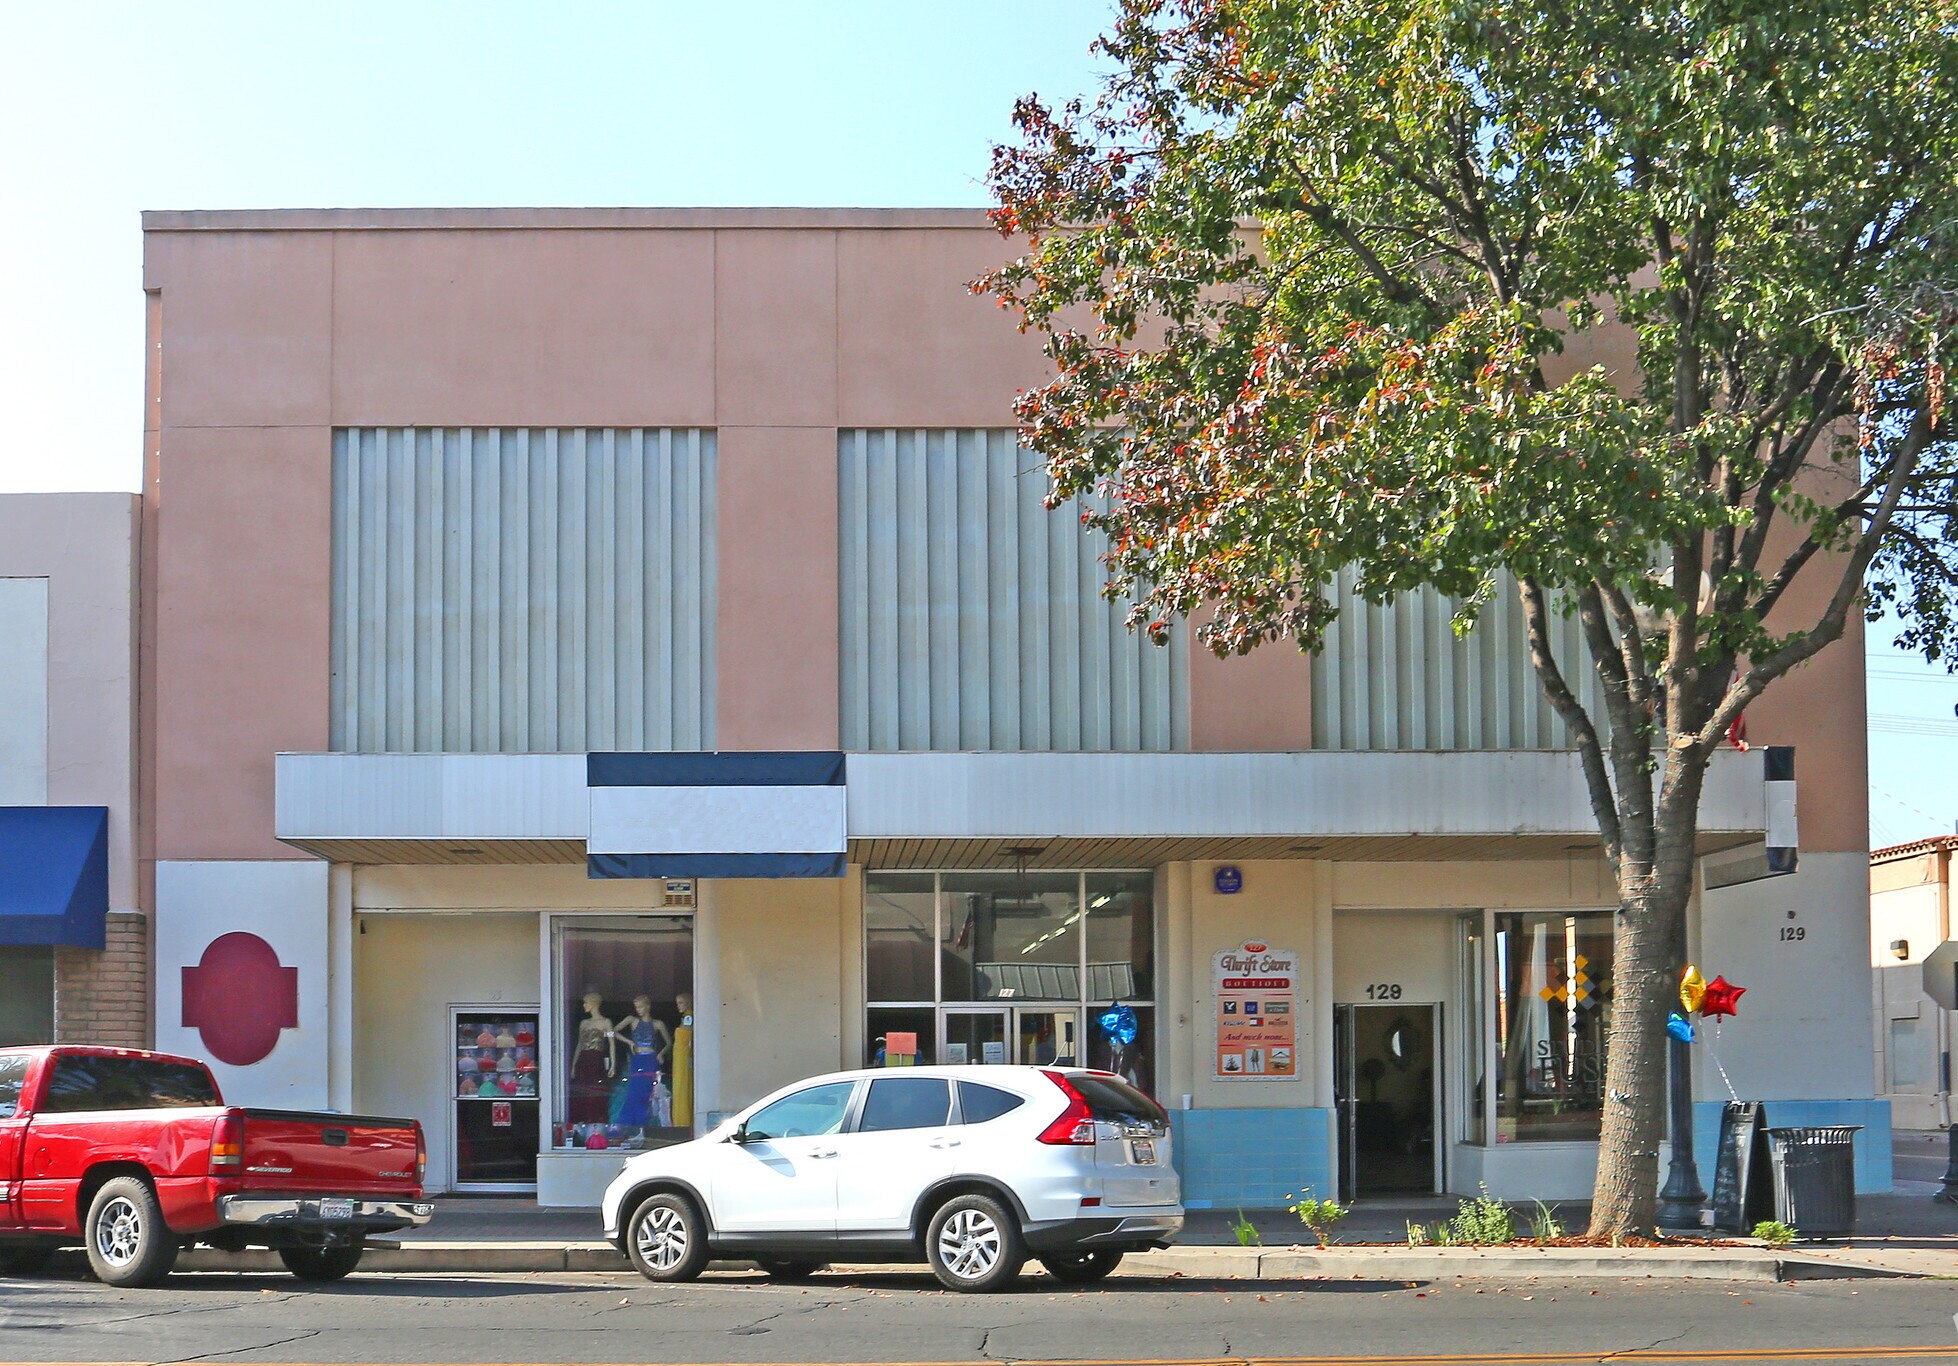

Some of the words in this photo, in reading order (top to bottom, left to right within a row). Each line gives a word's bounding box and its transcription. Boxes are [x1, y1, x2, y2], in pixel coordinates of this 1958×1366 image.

[1780, 926, 1806, 942] 129
[1221, 954, 1259, 977] Thrift
[1260, 955, 1291, 973] Store
[998, 988, 1015, 997] 127
[1366, 983, 1402, 1000] 129
[1224, 1032, 1243, 1041] And
[1243, 1032, 1262, 1041] much
